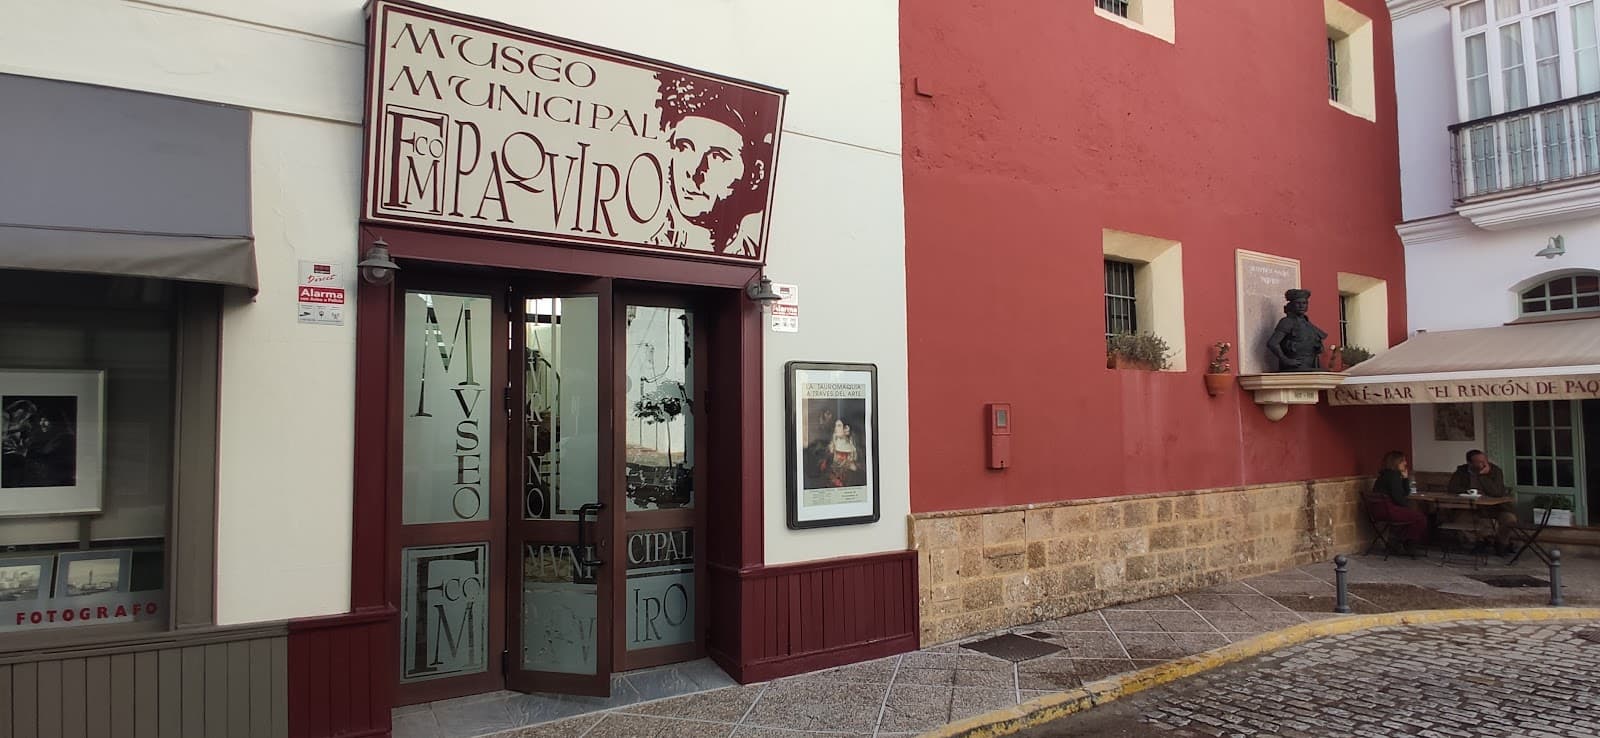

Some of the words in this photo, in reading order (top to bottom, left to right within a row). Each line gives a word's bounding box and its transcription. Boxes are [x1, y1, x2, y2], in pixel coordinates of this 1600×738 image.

[391, 23, 597, 89] MUSEO
[388, 65, 659, 141] MUNICIPAL
[448, 119, 663, 237] PAQVIRO
[300, 288, 344, 299] Alarma
[1536, 381, 1559, 395] DE
[1565, 379, 1600, 397] PAQ
[627, 530, 694, 564] CIPAL
[16, 602, 158, 625] FOTOGRAFO
[632, 583, 688, 643] IRO
